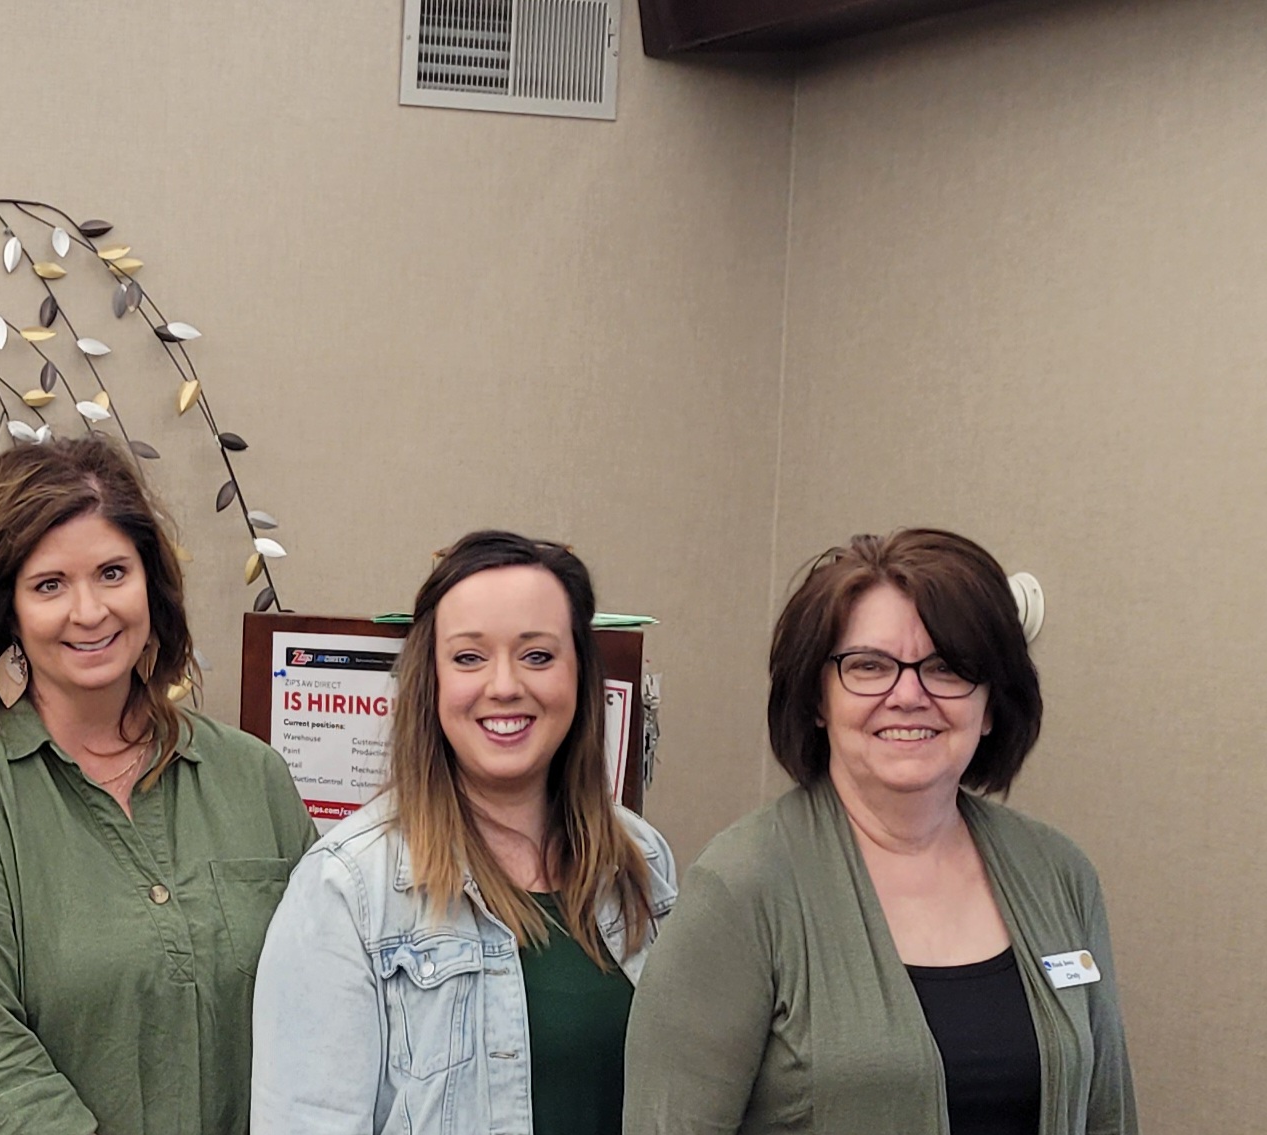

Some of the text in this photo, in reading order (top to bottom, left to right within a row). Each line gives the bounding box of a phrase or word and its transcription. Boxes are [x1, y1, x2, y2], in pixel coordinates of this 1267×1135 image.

[314, 681, 342, 690] DIRECT
[284, 691, 302, 711] IS
[283, 718, 345, 730] Current positions:
[283, 732, 321, 742] Warehouse
[283, 746, 301, 755] Paint
[288, 761, 303, 769] etail
[293, 775, 343, 786] duction Control
[308, 804, 354, 817] zips.com/ca
